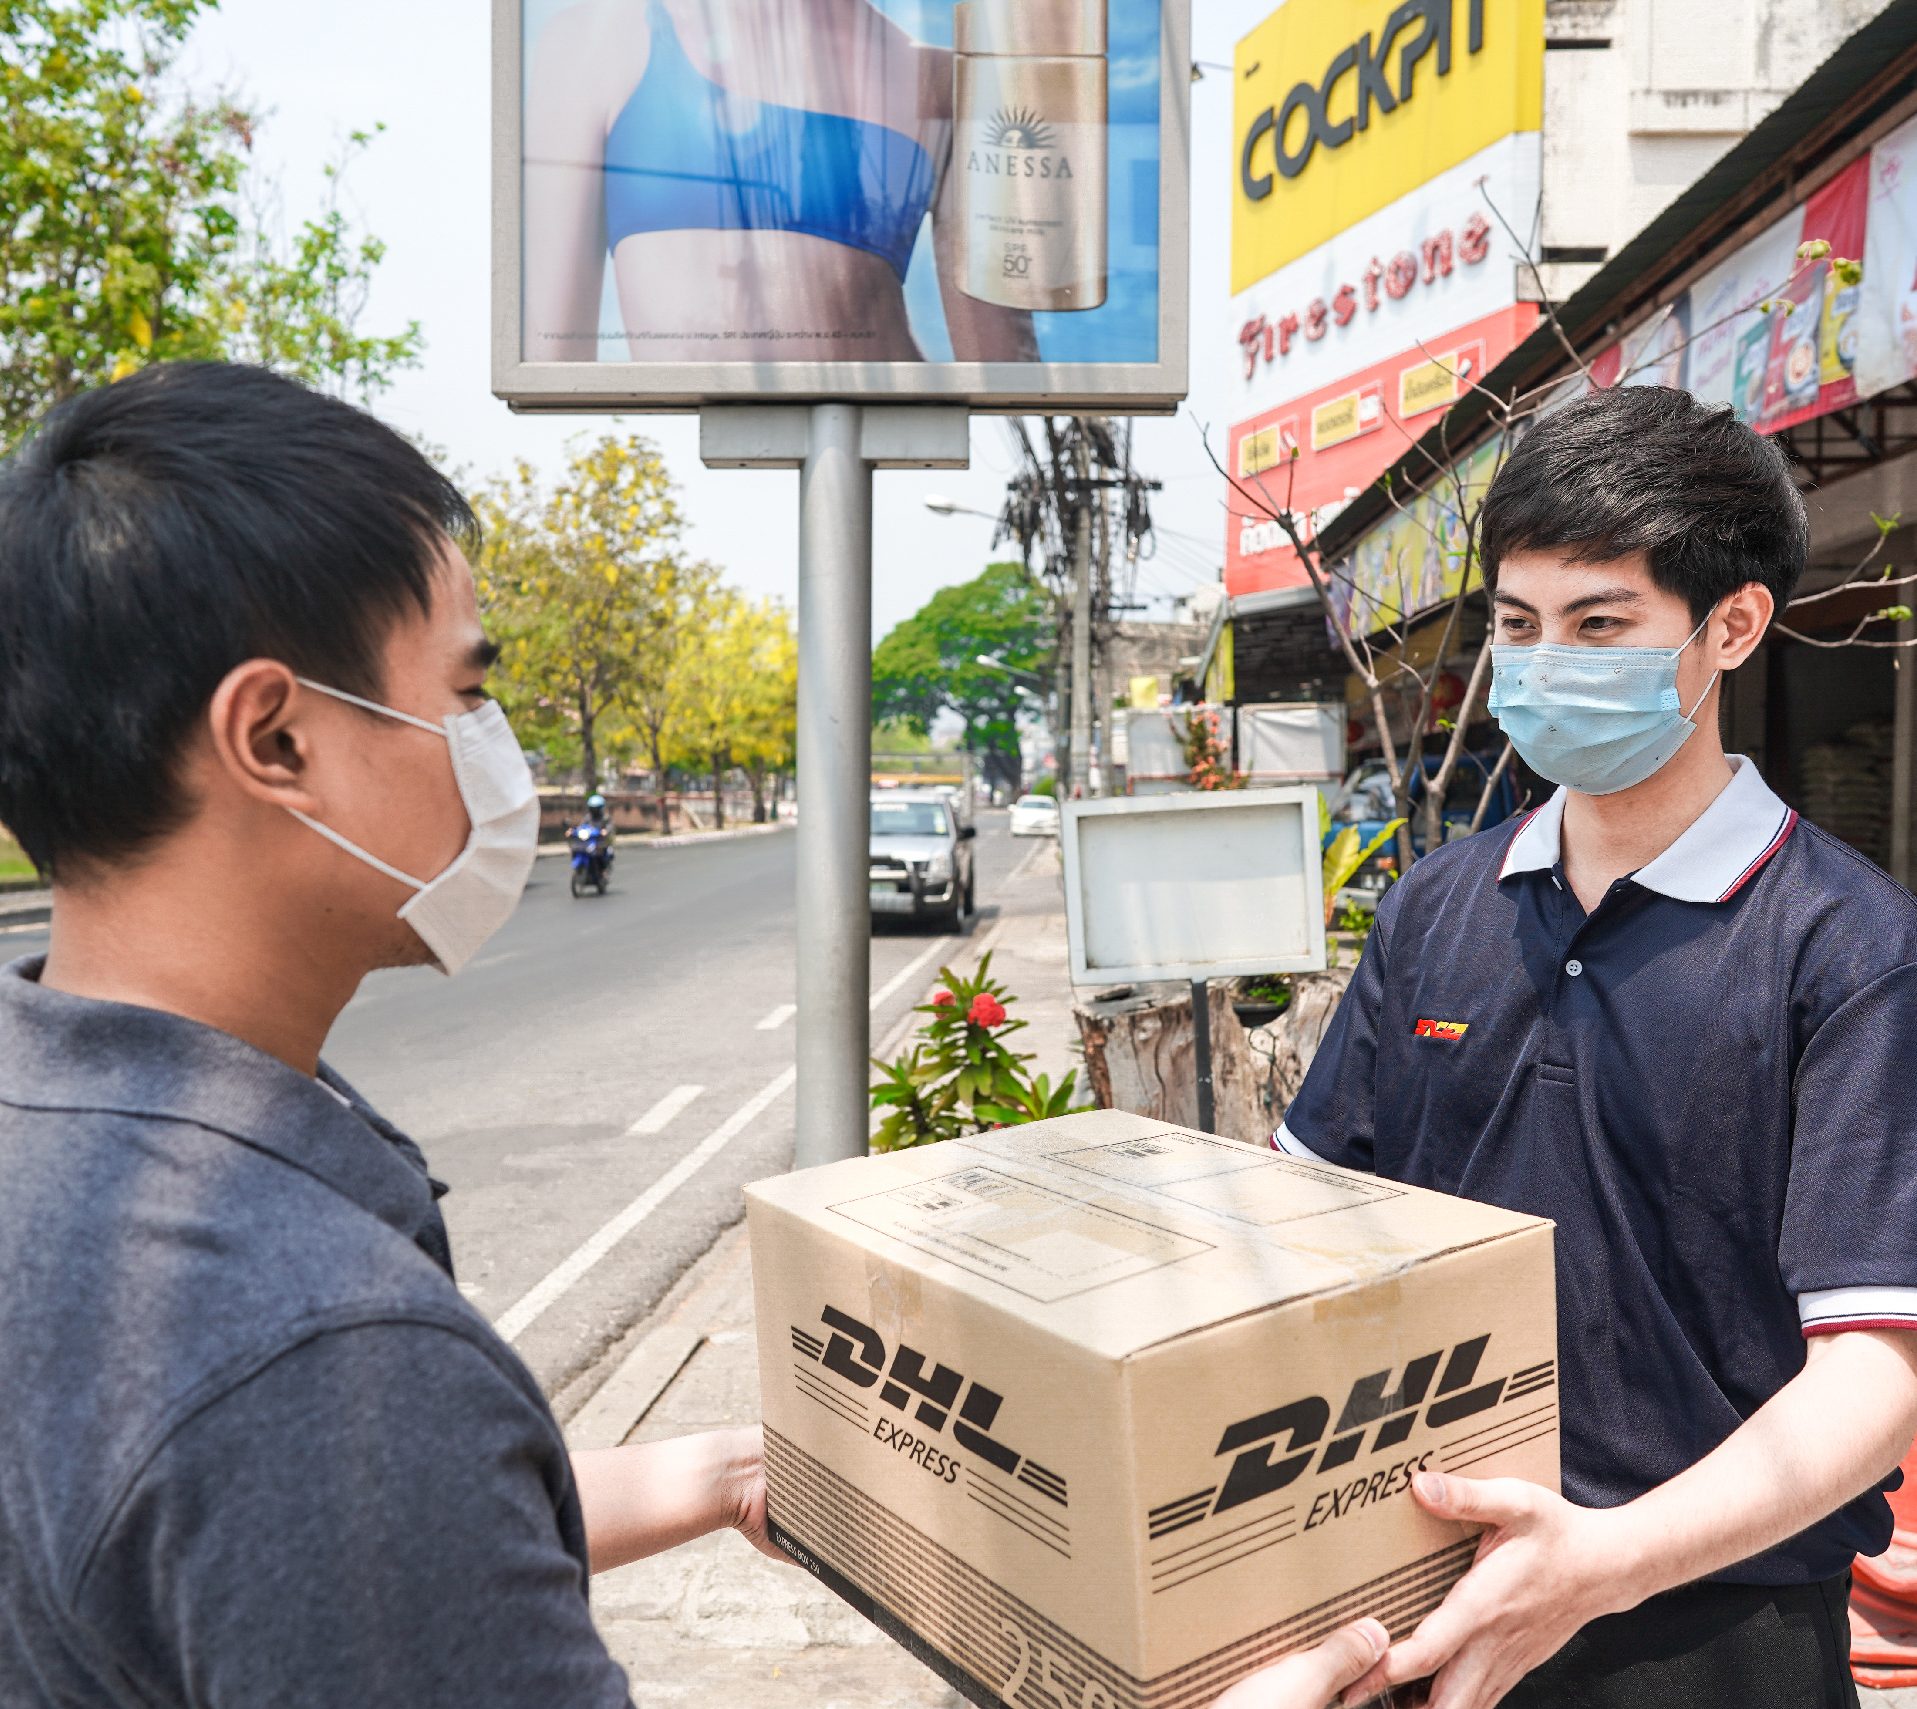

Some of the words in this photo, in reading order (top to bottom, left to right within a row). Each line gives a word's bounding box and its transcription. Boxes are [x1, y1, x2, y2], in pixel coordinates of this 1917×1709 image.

[967, 151, 1073, 178] ANESSA
[1239, 211, 1490, 381] Firestone
[821, 1304, 1022, 1476] DHL
[873, 1417, 961, 1483] EXPRESS
[1212, 1333, 1508, 1516] DHL
[1304, 1450, 1434, 1531] EXPRESS
